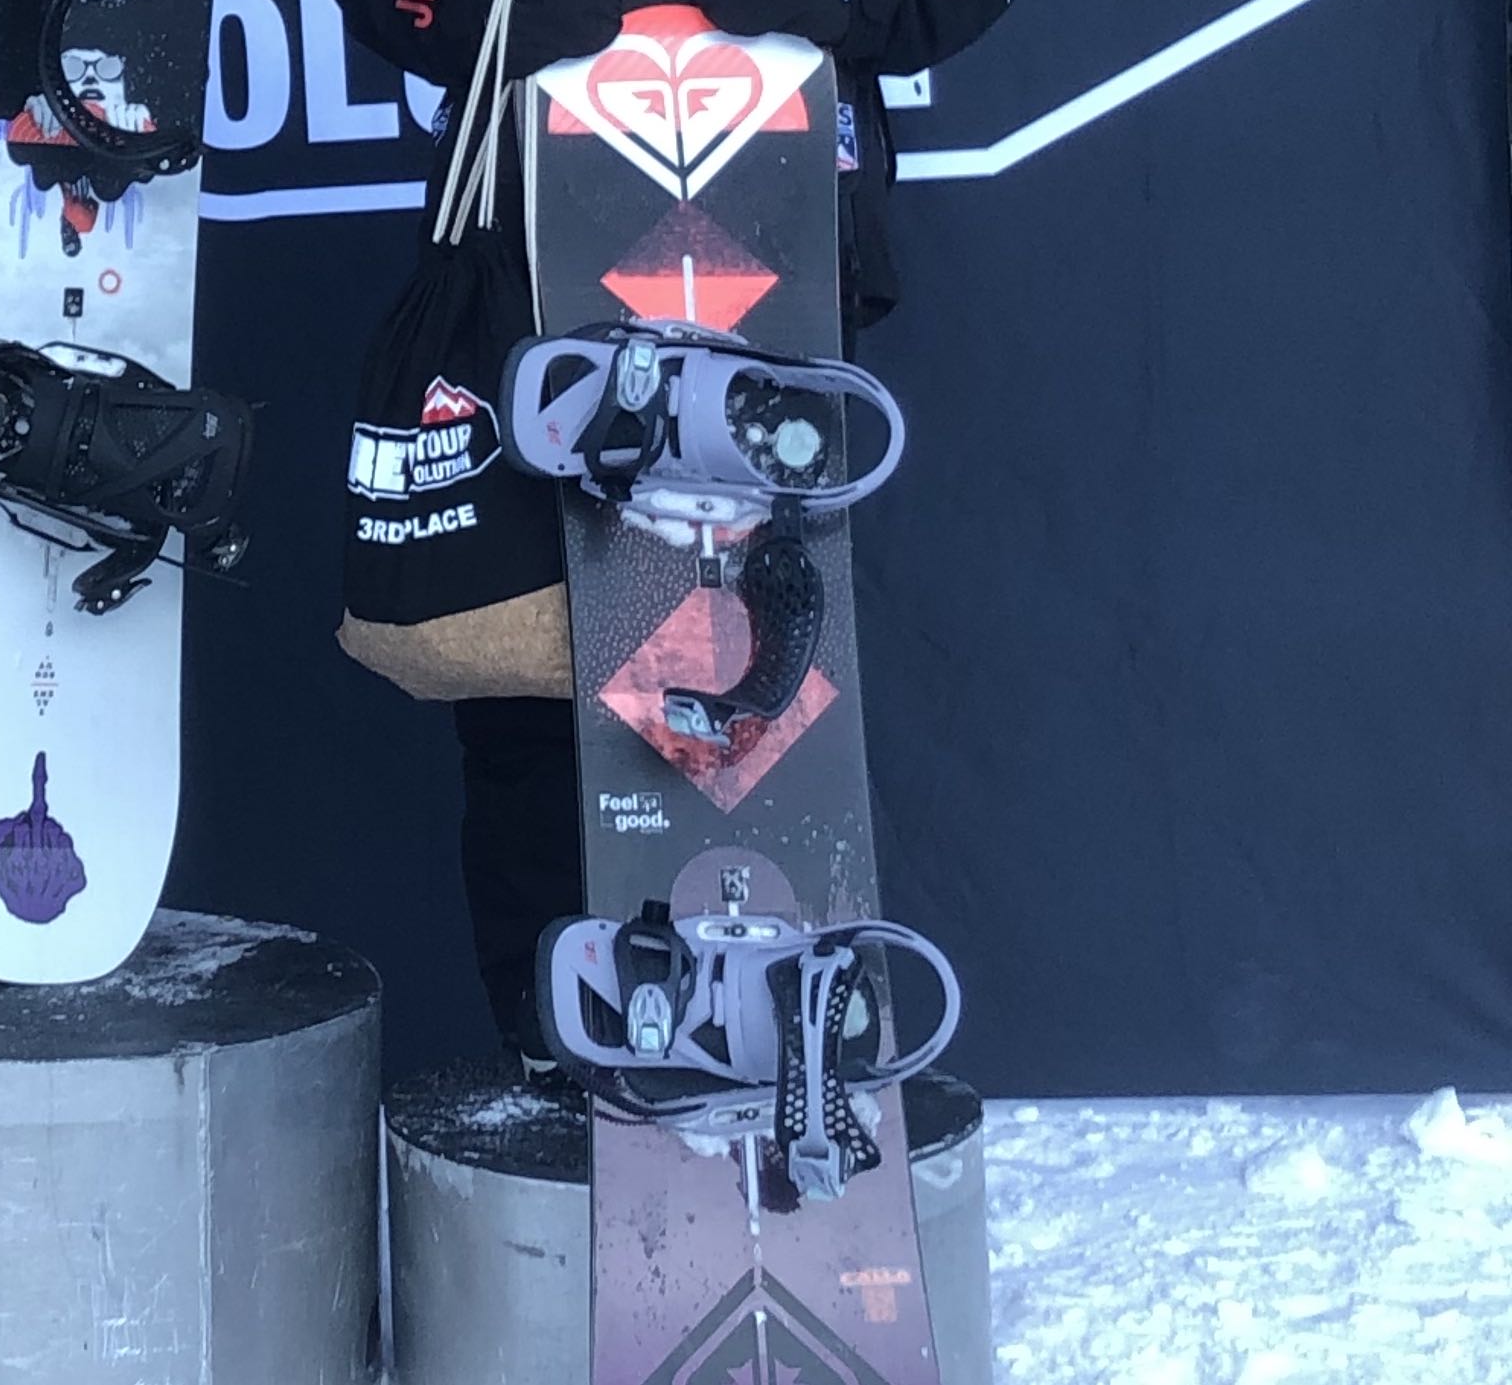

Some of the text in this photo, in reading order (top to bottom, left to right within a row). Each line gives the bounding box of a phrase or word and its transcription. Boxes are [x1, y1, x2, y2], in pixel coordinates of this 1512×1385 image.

[356, 503, 478, 545] 3RD LACE
[615, 809, 670, 833] good.
